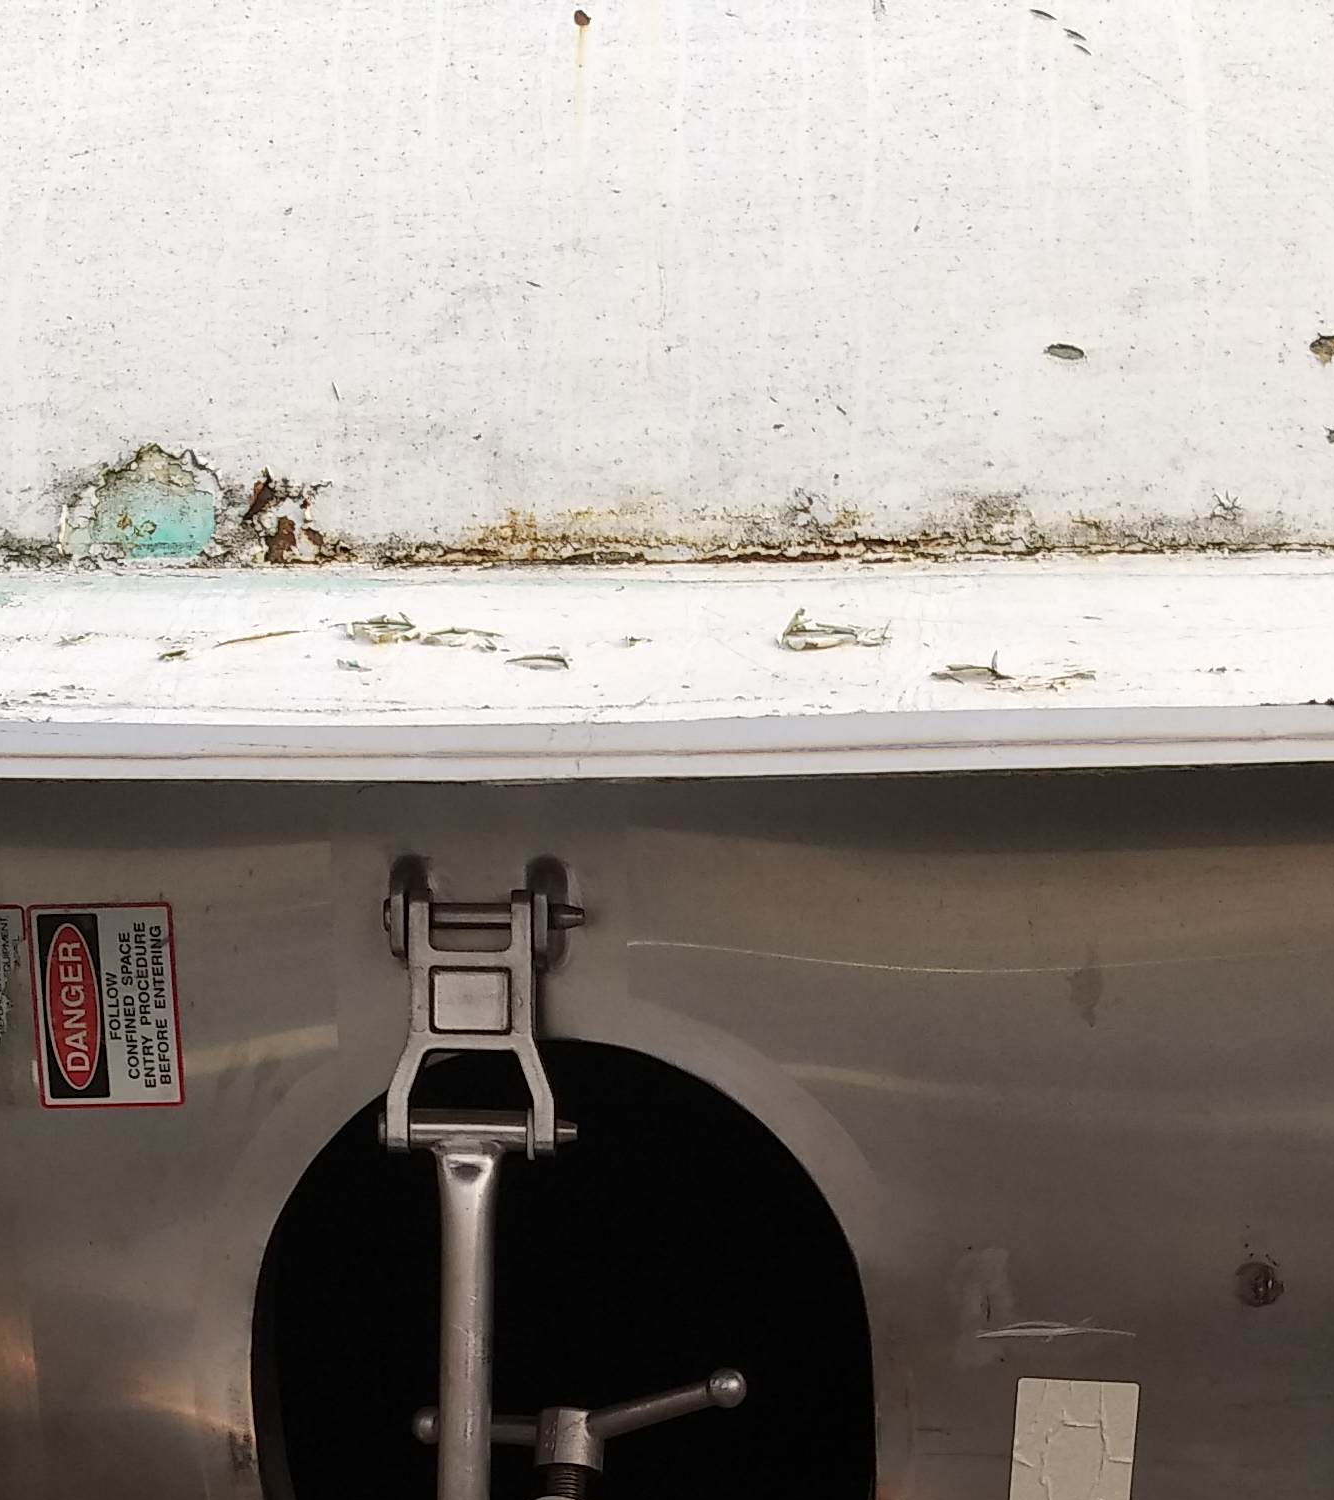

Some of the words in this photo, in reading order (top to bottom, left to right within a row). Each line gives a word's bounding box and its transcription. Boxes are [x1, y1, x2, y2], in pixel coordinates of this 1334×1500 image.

[119, 932, 133, 986] SPACE
[134, 922, 151, 1025] PROCEDURE
[150, 925, 166, 1008] ENTERING
[58, 942, 90, 1072] DANGER
[106, 972, 121, 1040] FOLLOW
[123, 995, 140, 1079] CONFINED
[142, 1035, 156, 1088] ENTRY
[156, 1019, 171, 1084] BEFORE
